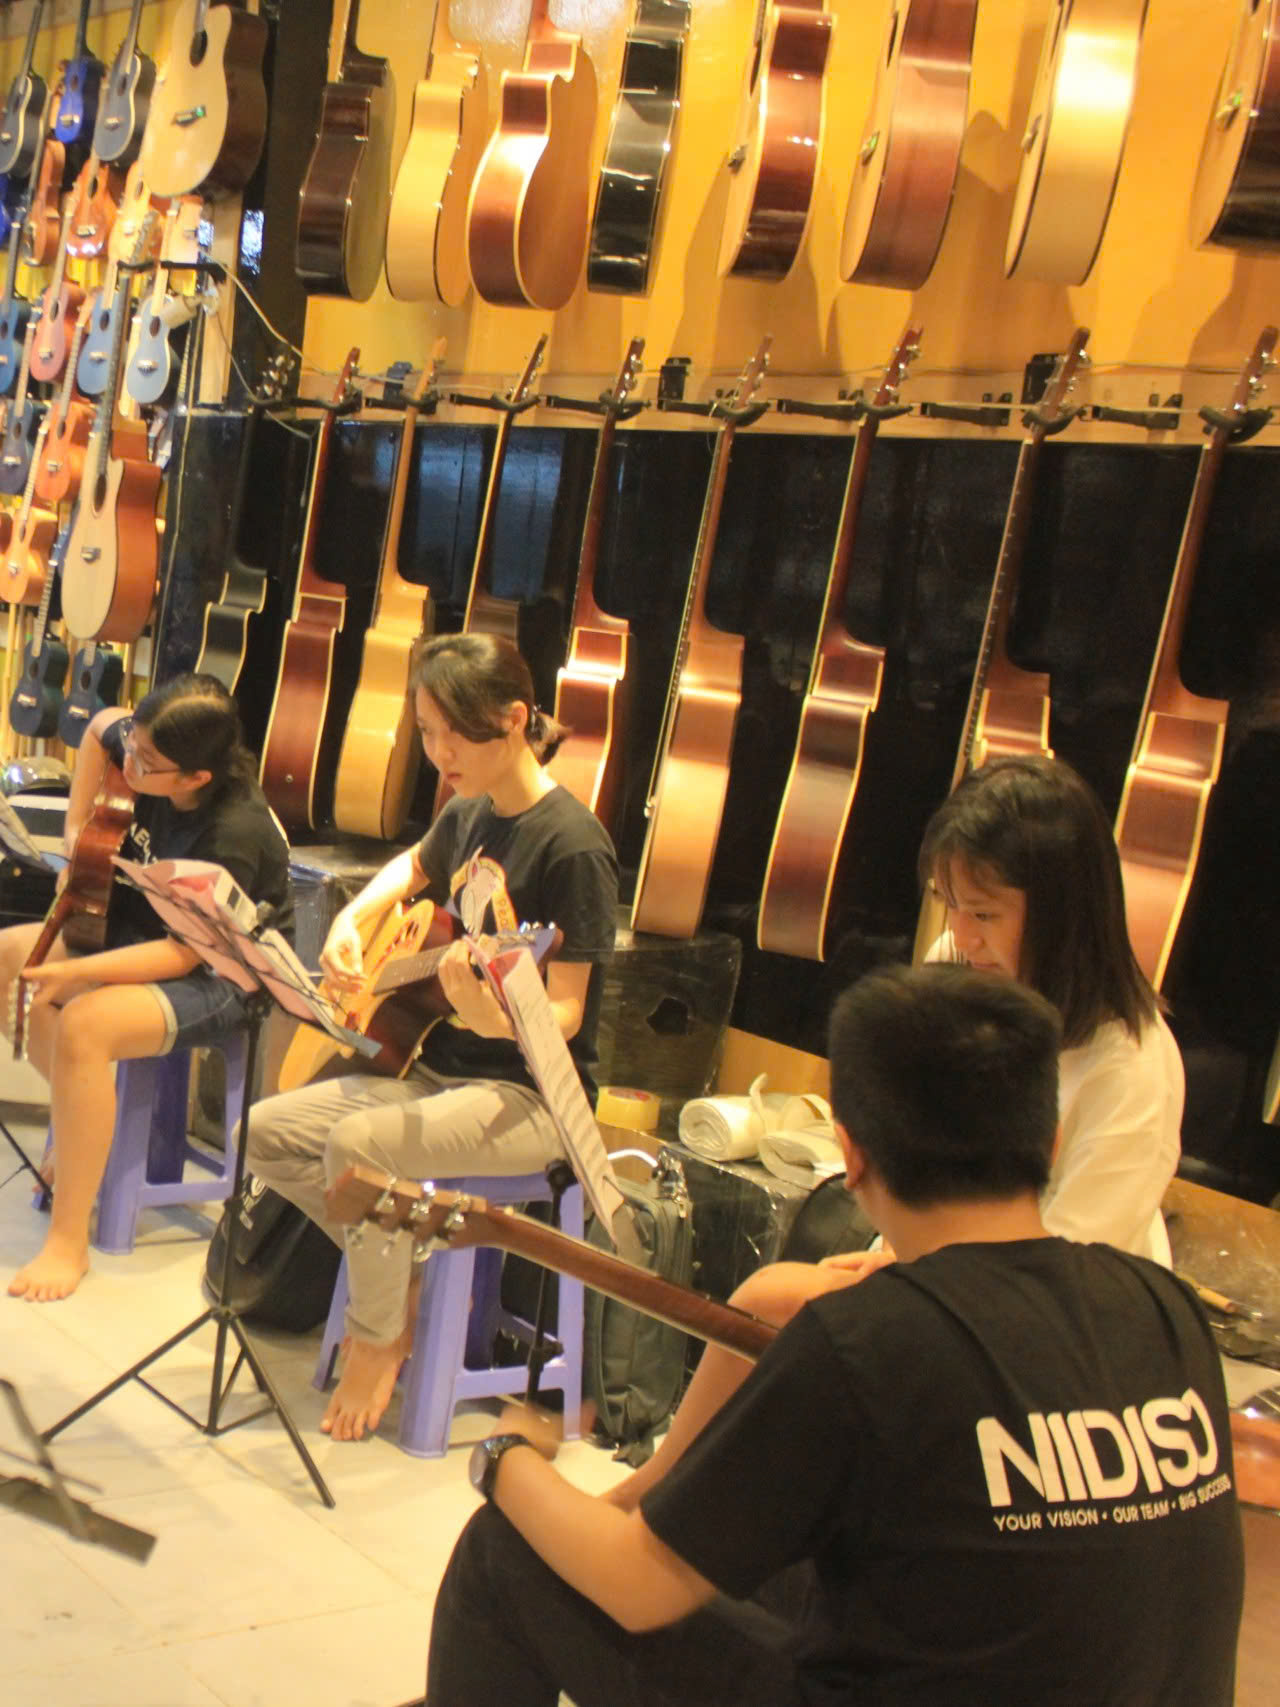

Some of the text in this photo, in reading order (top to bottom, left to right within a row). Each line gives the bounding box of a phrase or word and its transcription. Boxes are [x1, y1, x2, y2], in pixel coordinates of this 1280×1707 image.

[993, 1512, 1042, 1532] YOUR
[1047, 1508, 1099, 1527] VISION
[1113, 1507, 1139, 1523] OUR
[1141, 1500, 1170, 1521] TEAM
[1178, 1494, 1197, 1512] BIG
